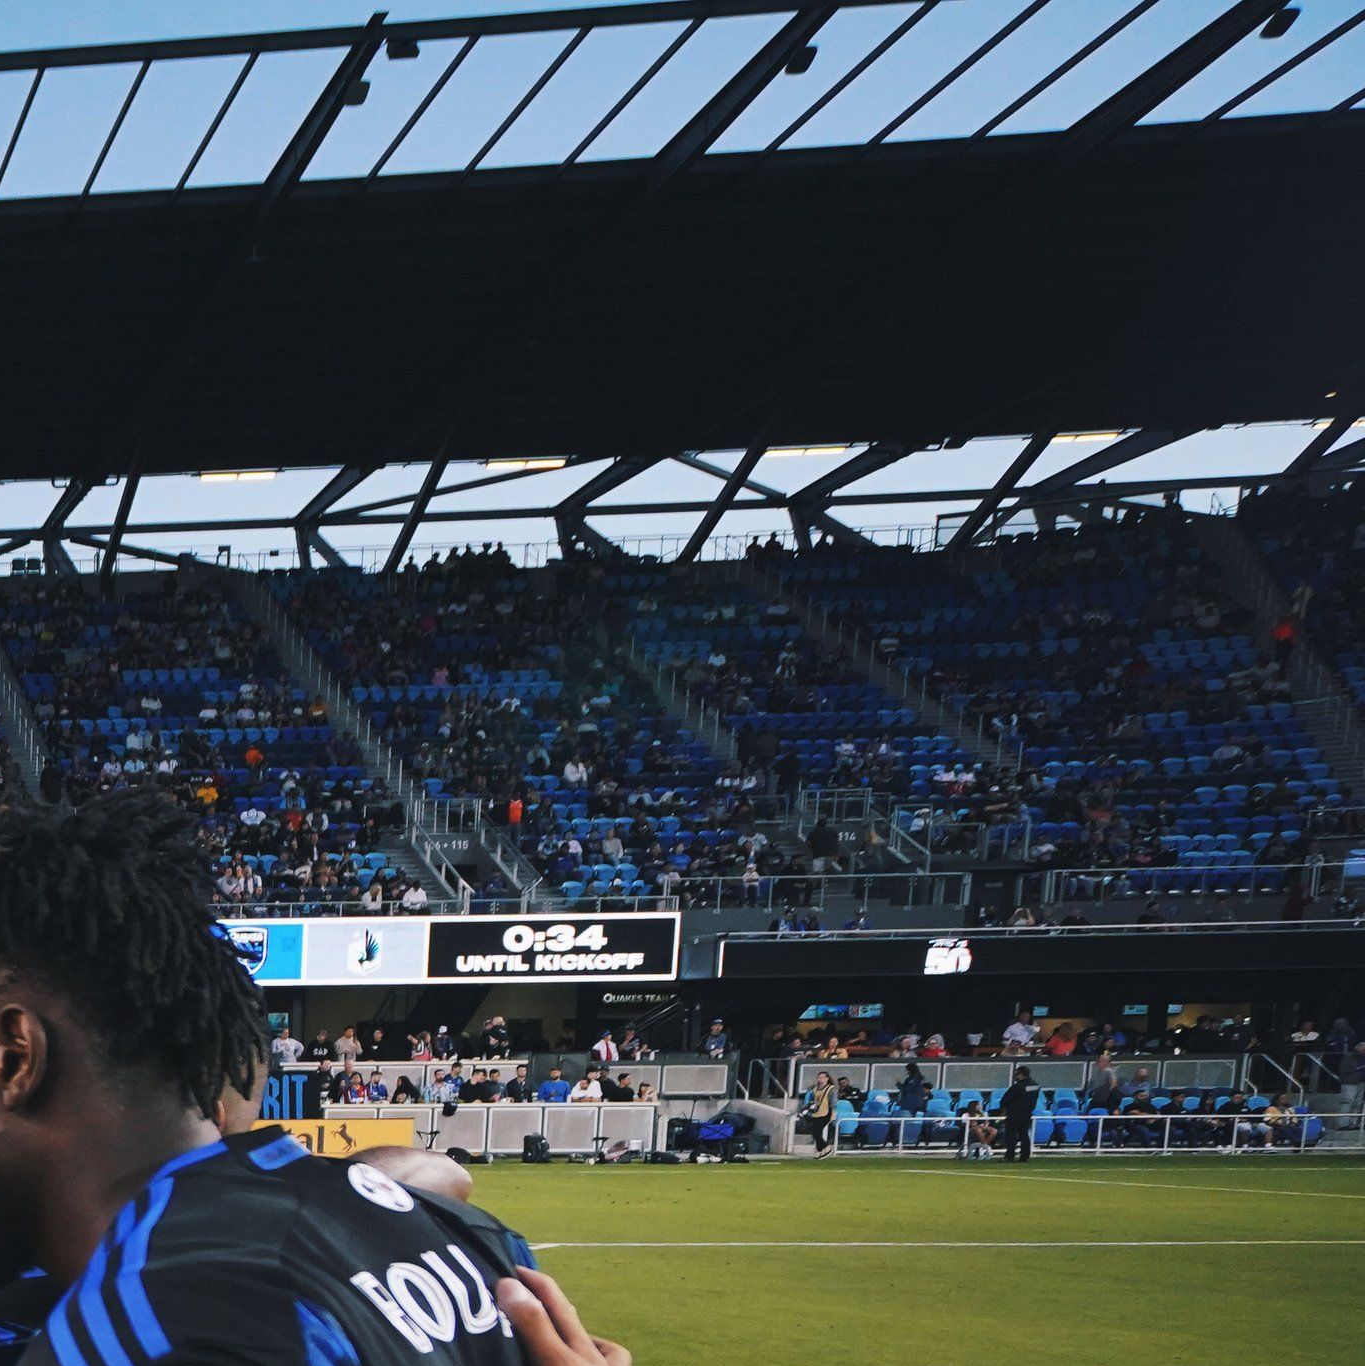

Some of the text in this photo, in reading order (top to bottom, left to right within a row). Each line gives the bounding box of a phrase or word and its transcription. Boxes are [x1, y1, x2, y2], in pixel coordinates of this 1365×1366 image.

[502, 924, 608, 953] 0:34
[456, 952, 645, 973] UNTIL KICKOFF
